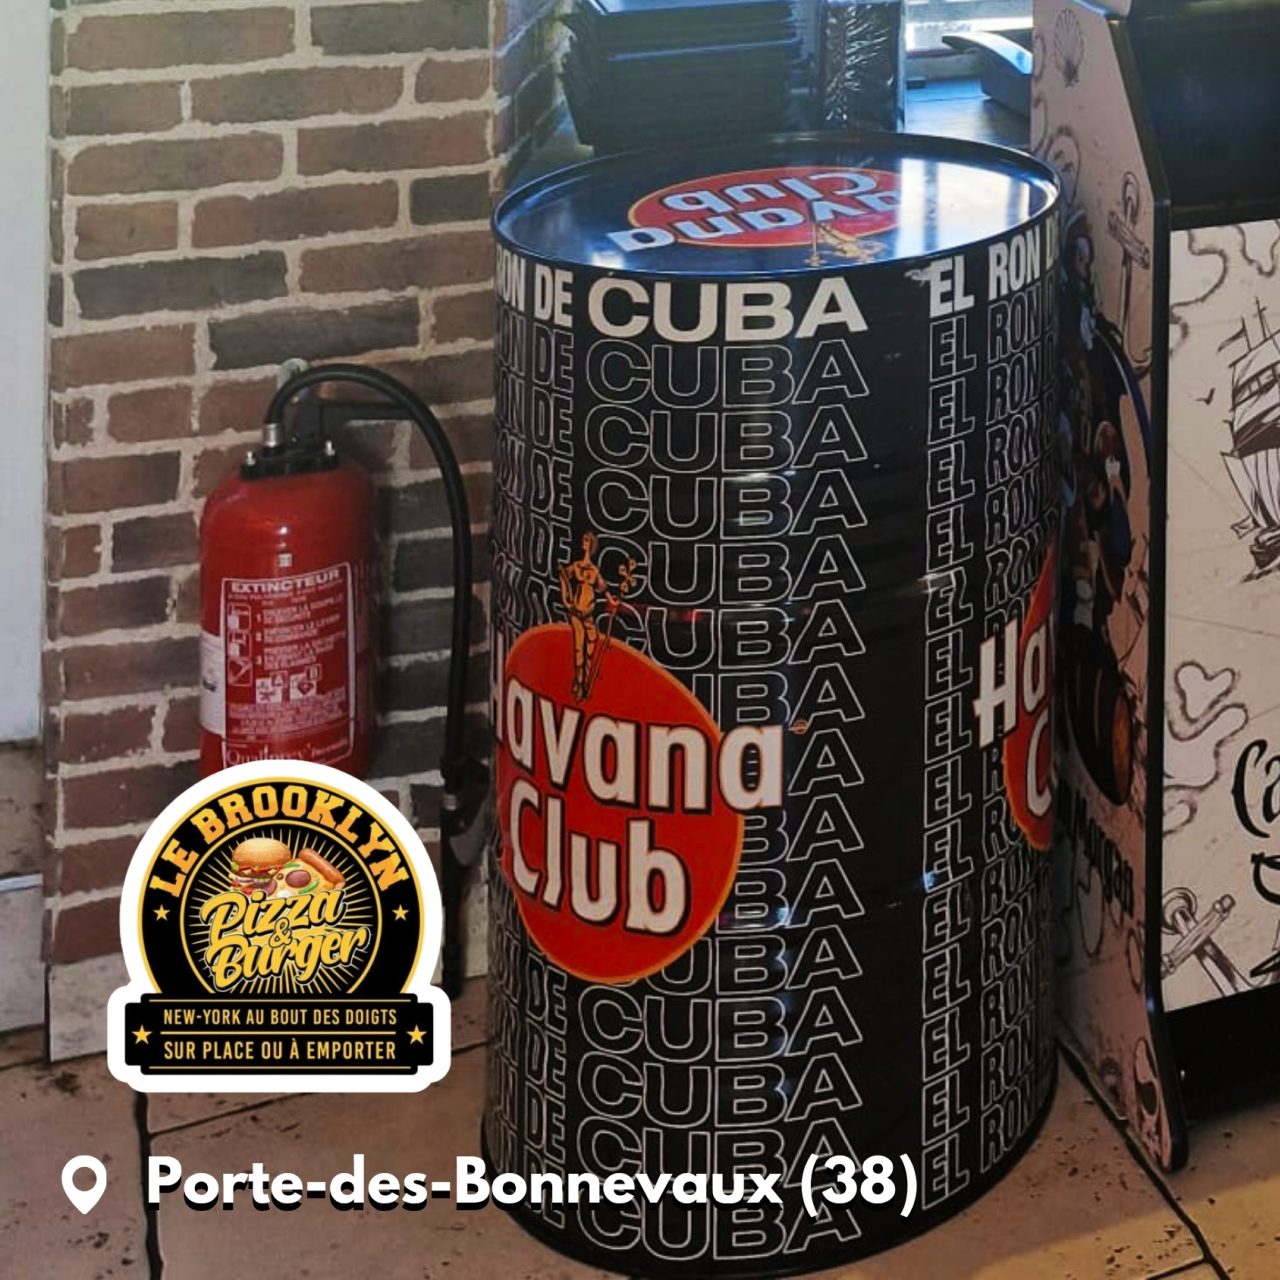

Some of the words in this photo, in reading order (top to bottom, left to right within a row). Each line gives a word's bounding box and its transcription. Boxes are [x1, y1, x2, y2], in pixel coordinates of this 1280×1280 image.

[606, 190, 900, 252] avana
[533, 267, 575, 329] DE
[587, 276, 870, 343] CUBA
[929, 256, 976, 319] EL
[988, 226, 1041, 302] RON
[532, 323, 575, 393] DE
[586, 338, 870, 408] CUBA
[929, 315, 977, 382] EL
[988, 282, 1041, 364] RON
[585, 403, 869, 474] CUBA
[927, 440, 975, 510] EL
[985, 402, 1040, 488] RON
[530, 448, 573, 521] DE
[584, 468, 868, 540] CUBA
[230, 569, 341, 593] EXTINCTEUR
[501, 676, 784, 812] avana
[924, 693, 973, 763] EL
[505, 776, 688, 936] Club
[923, 819, 973, 893] EL
[922, 944, 972, 1018] EL
[981, 884, 1036, 985] RON
[578, 986, 863, 1063] CUBA
[922, 1007, 971, 1082] EL
[980, 946, 1035, 1047] RON
[577, 1052, 863, 1128] CUBA
